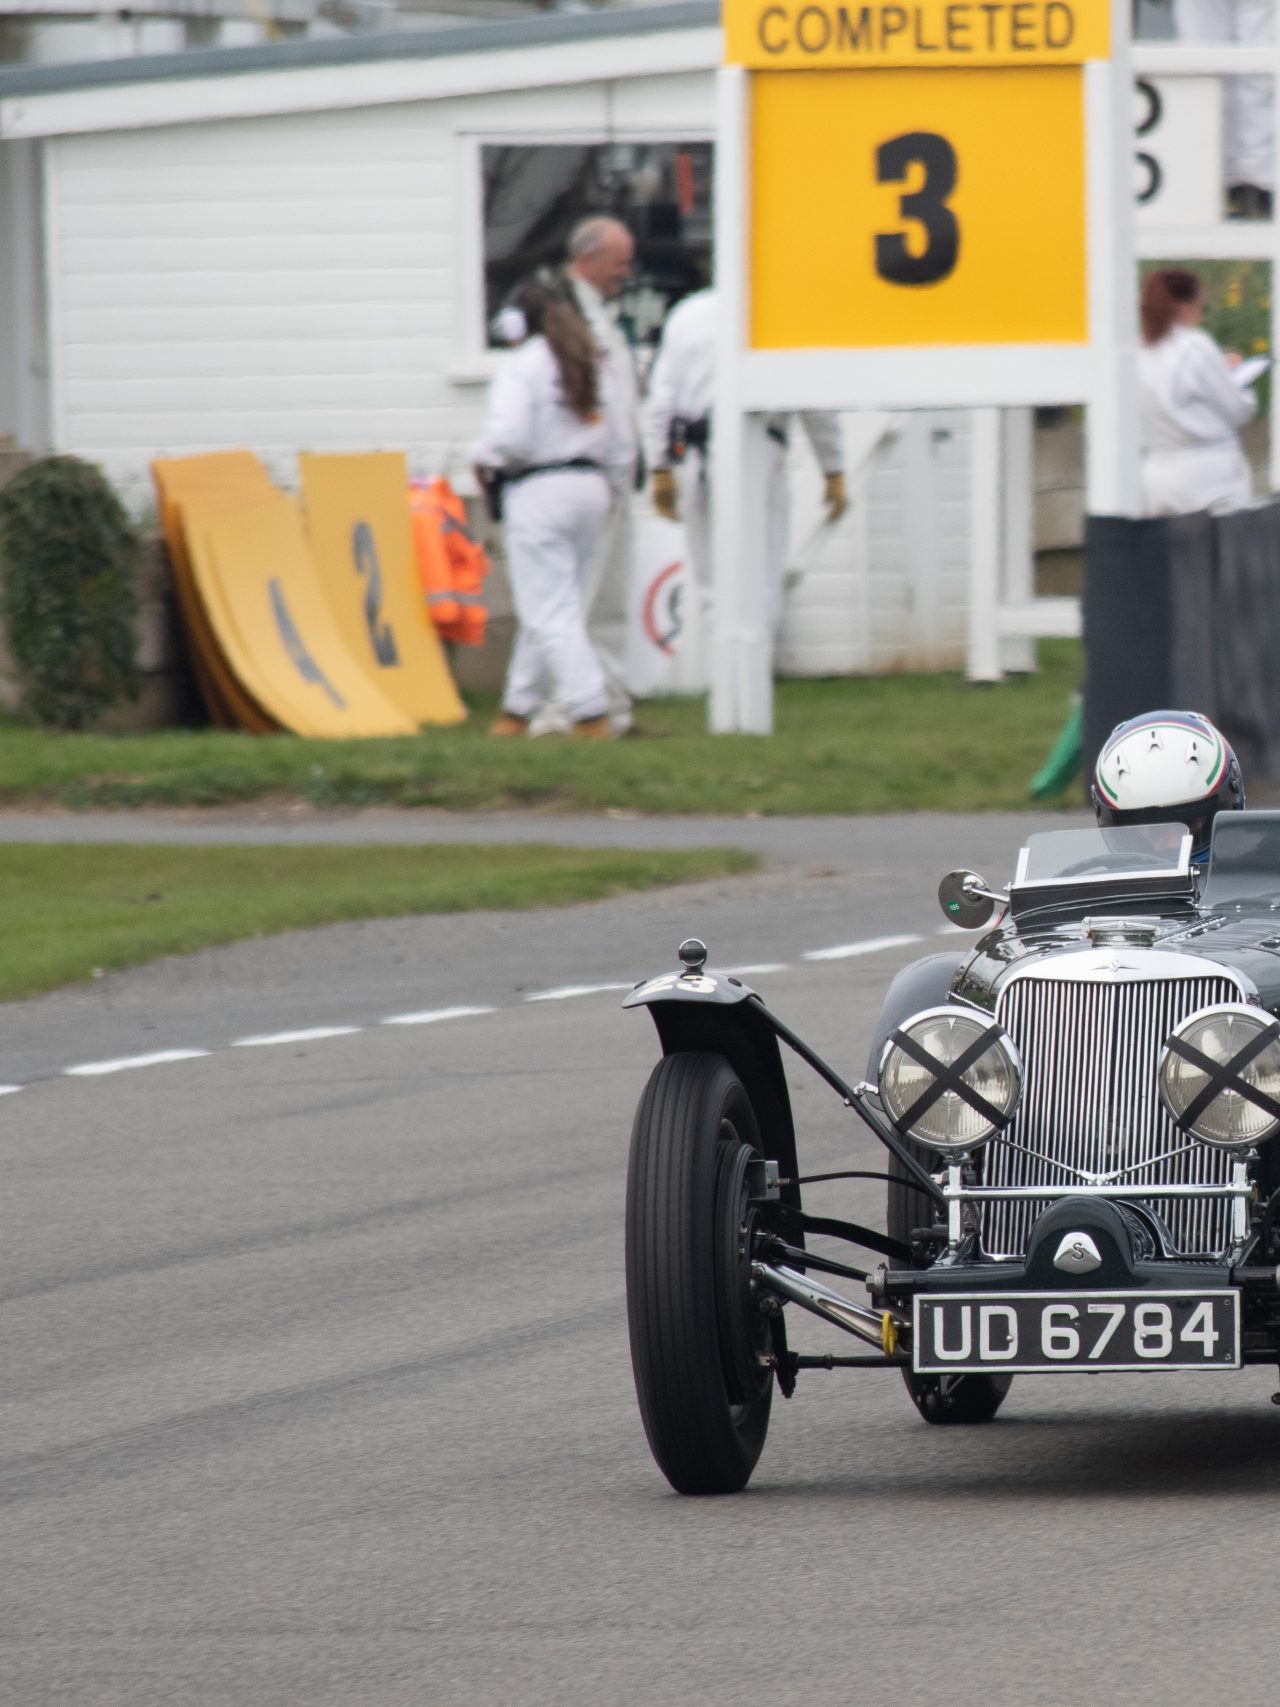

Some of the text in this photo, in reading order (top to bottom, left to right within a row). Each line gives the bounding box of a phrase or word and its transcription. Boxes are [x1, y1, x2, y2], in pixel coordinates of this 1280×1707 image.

[757, 2, 1075, 54] COMPLETED
[873, 131, 959, 287] 3
[353, 520, 400, 669] 2
[1072, 1242, 1084, 1260] S
[933, 1301, 1219, 1361] UD 6784
